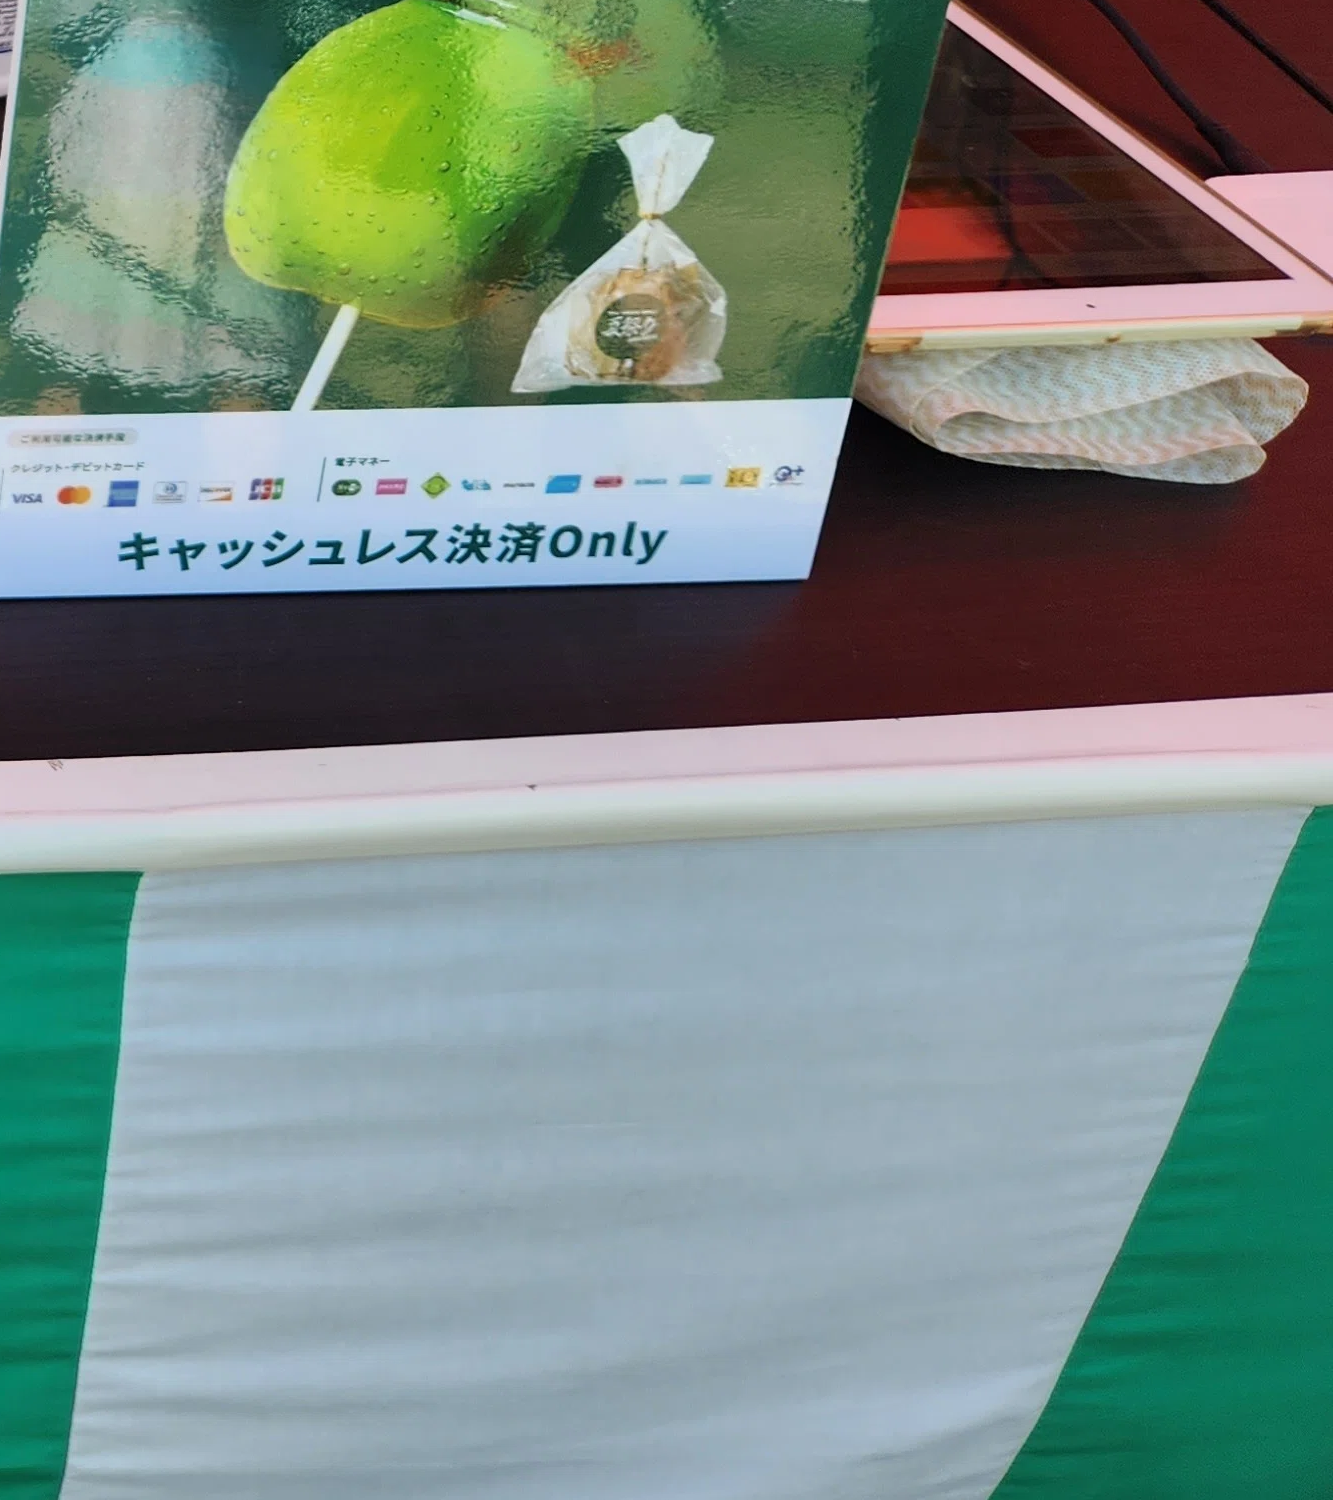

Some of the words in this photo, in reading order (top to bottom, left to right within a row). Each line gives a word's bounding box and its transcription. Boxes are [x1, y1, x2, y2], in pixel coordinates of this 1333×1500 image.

[12, 493, 43, 504] VISA
[116, 522, 670, 574] キャッシュレス決済Only
